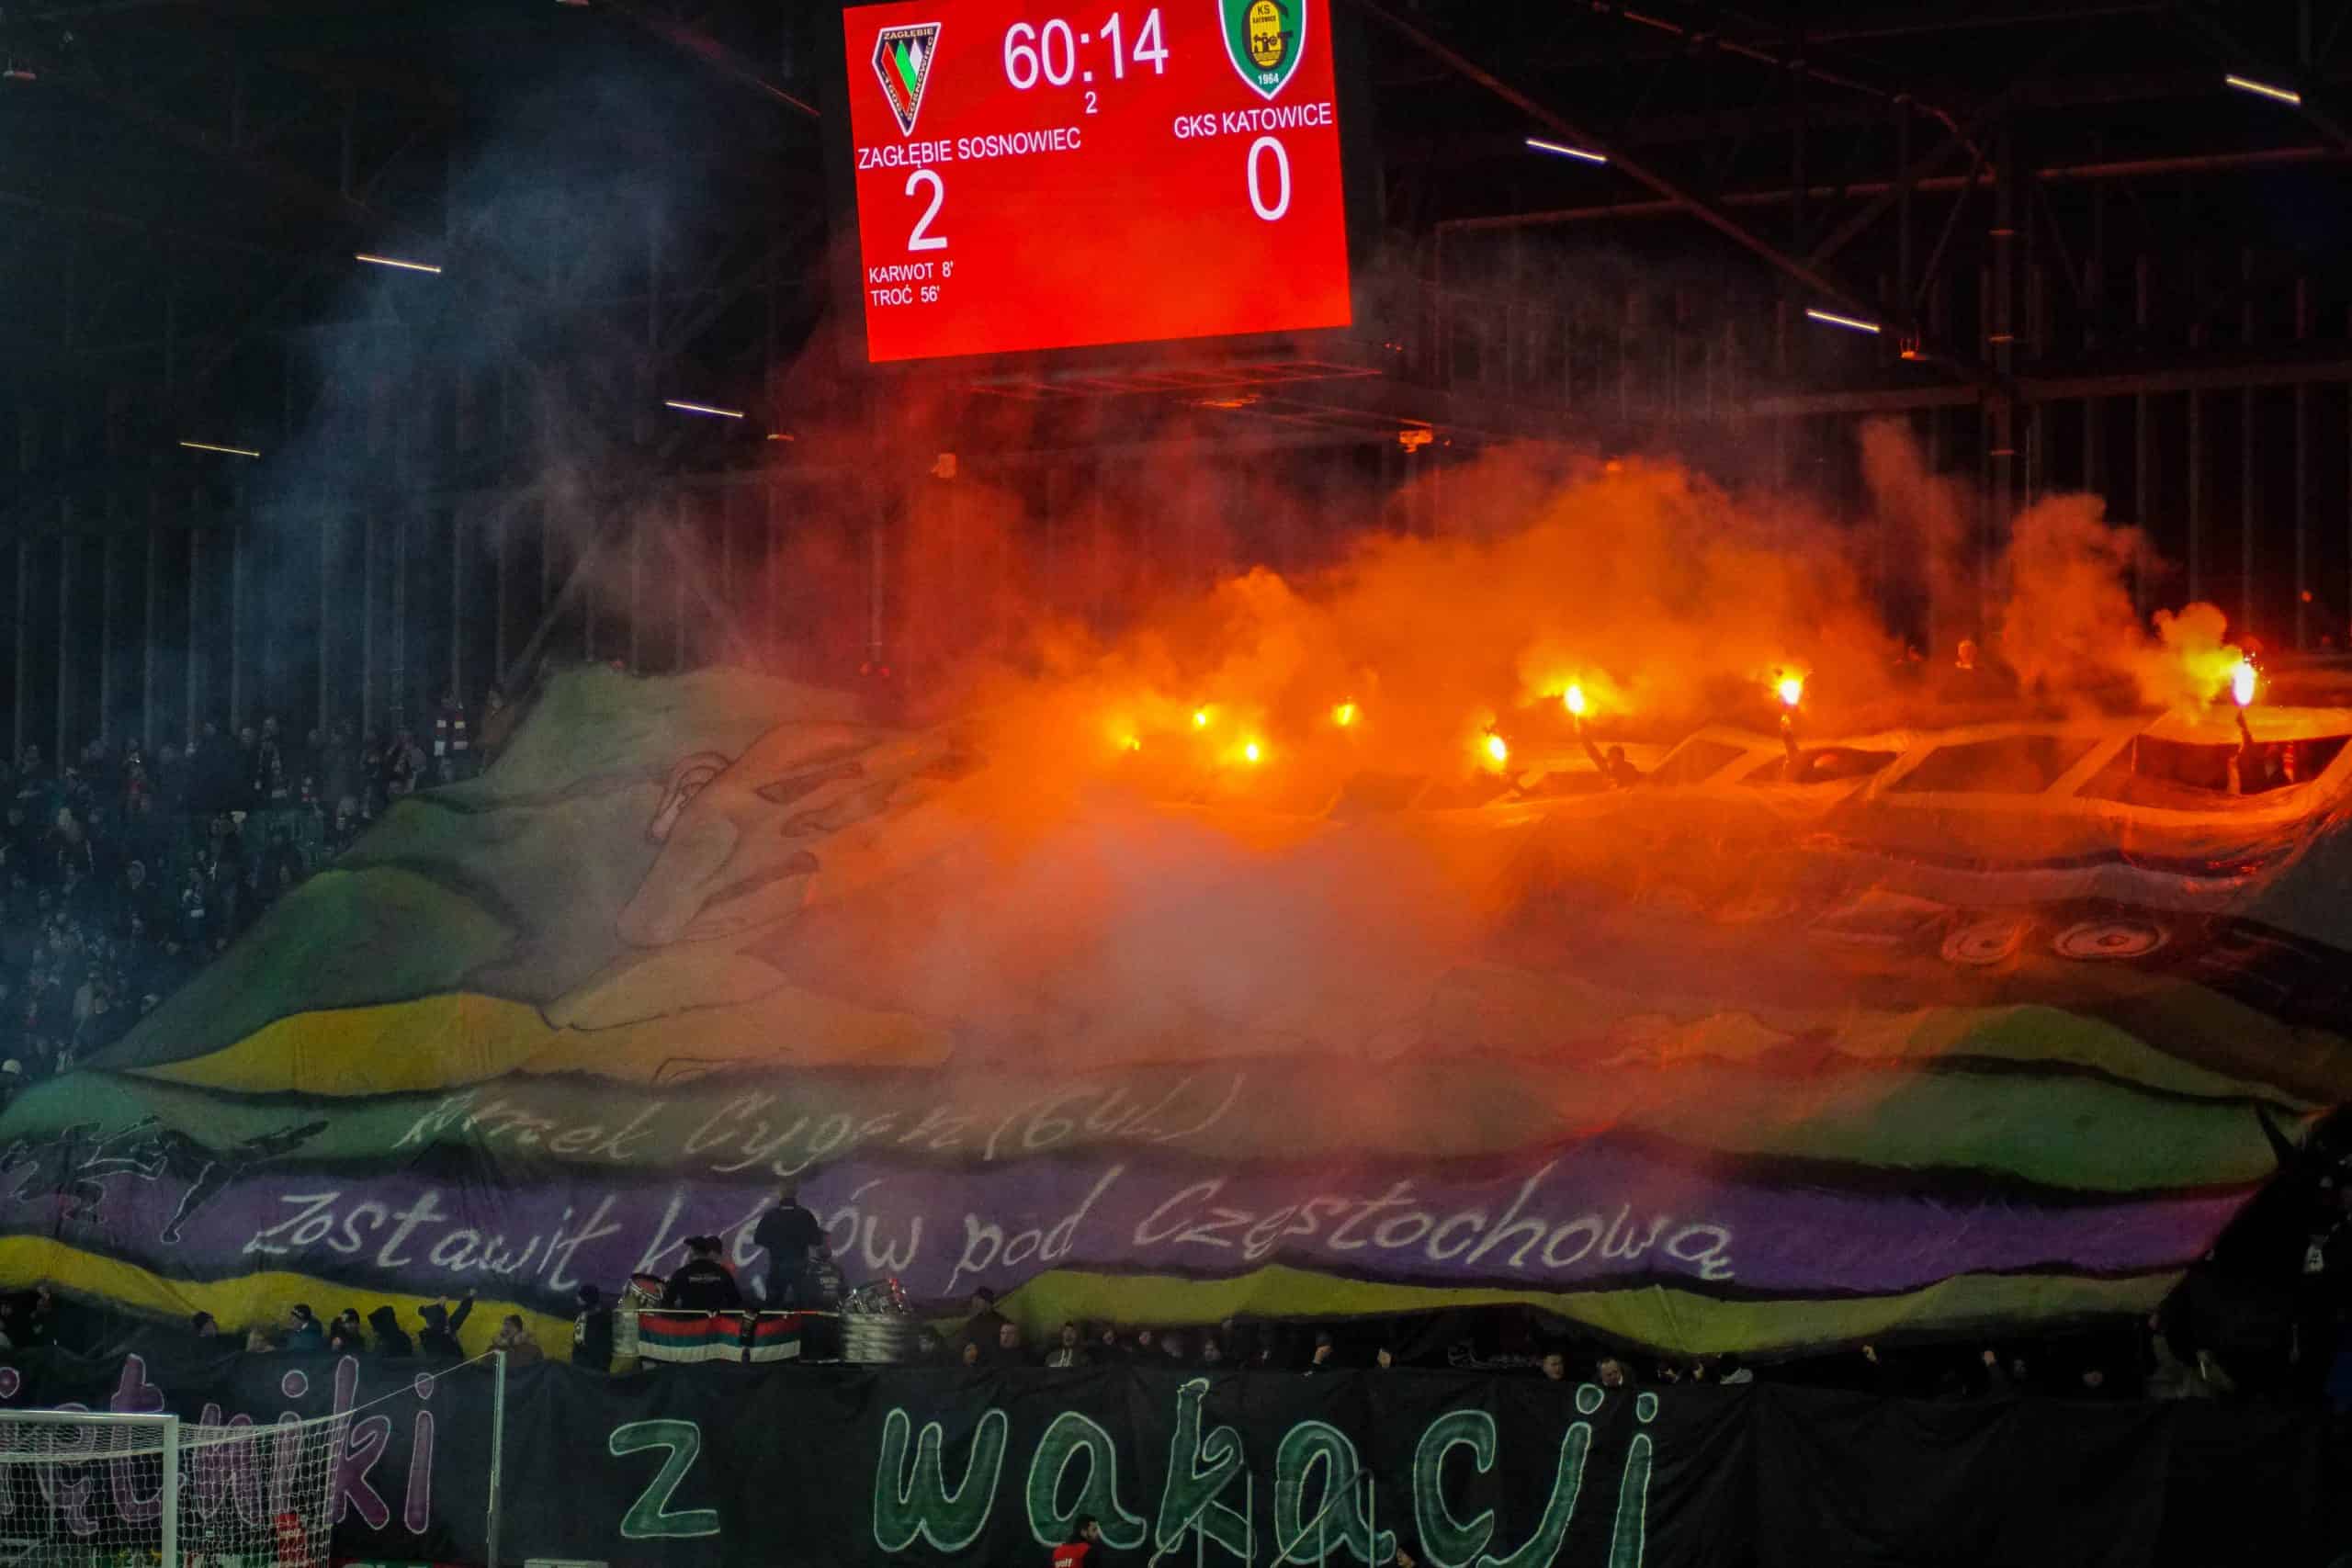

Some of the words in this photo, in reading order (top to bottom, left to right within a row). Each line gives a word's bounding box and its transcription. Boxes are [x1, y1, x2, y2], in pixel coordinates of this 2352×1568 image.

[1003, 7, 1170, 90] 60:14
[1258, 73, 1280, 85] 1964
[1085, 91, 1098, 114] 2
[1174, 113, 1217, 139] GKS
[1222, 102, 1332, 134] KATOWICE
[858, 142, 953, 171] ZAGŁĘBIE
[957, 127, 1081, 160] SOSNOWIEC
[1248, 136, 1291, 220] 0
[905, 169, 948, 251] 2
[869, 263, 934, 284] KARWOT
[942, 261, 954, 277] 8'
[871, 285, 913, 306] TROĆ
[921, 286, 940, 304] 56'
[943, 1165, 1125, 1295] pod
[1132, 1159, 1736, 1280] Częstochową
[609, 1418, 721, 1539] z
[873, 1378, 1659, 1568] wakacji
